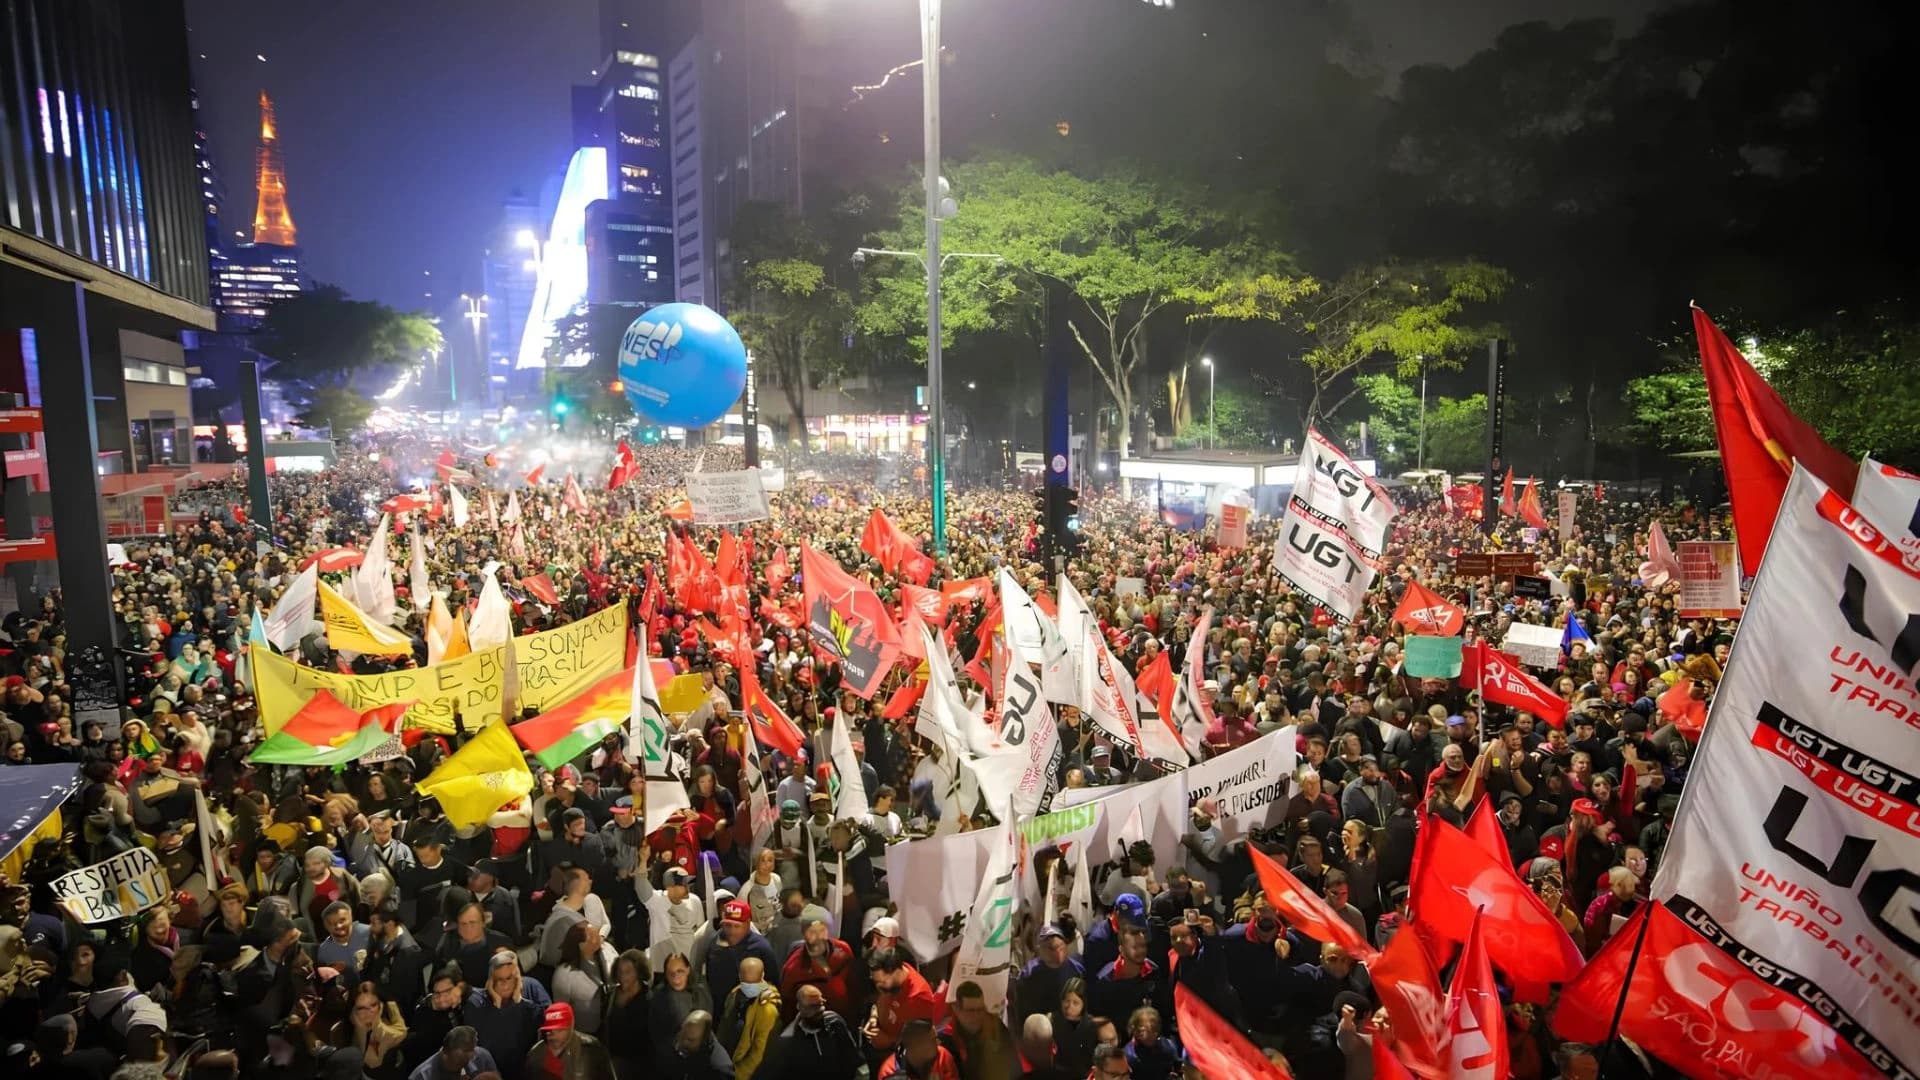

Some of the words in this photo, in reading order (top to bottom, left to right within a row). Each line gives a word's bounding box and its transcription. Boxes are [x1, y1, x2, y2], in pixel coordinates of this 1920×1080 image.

[1289, 523, 1362, 583] UGT
[436, 662, 463, 690] E
[519, 648, 595, 692] RASIL
[1775, 737, 1829, 779] UGT
[1833, 775, 1902, 817] UGT
[1779, 718, 1839, 758] UGT
[1842, 753, 1912, 795] UGT
[54, 849, 160, 898] RESPEITA
[1740, 862, 1843, 926] UNIÃO
[1685, 907, 1734, 948] UGT
[1737, 949, 1795, 987] UGT
[1798, 982, 1853, 1029] UGT
